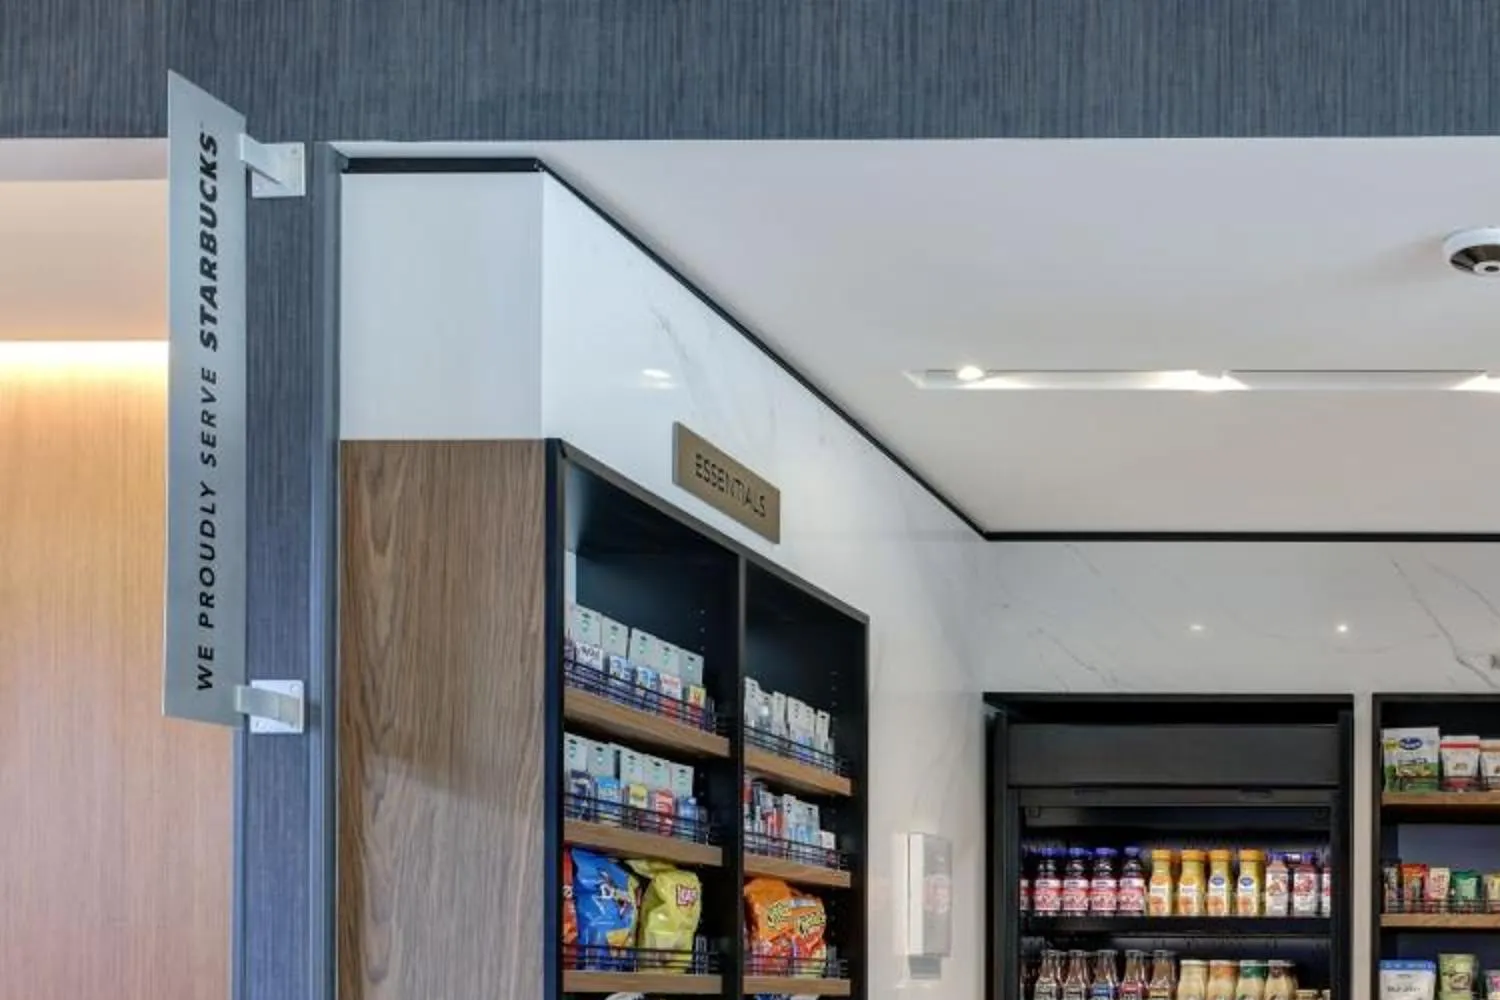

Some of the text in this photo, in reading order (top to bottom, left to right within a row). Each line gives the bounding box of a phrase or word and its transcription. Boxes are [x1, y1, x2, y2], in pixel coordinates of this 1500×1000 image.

[196, 131, 219, 691] WE PROUDLY SERVE STARBUCKS
[694, 452, 767, 519] ESSENTIALS
